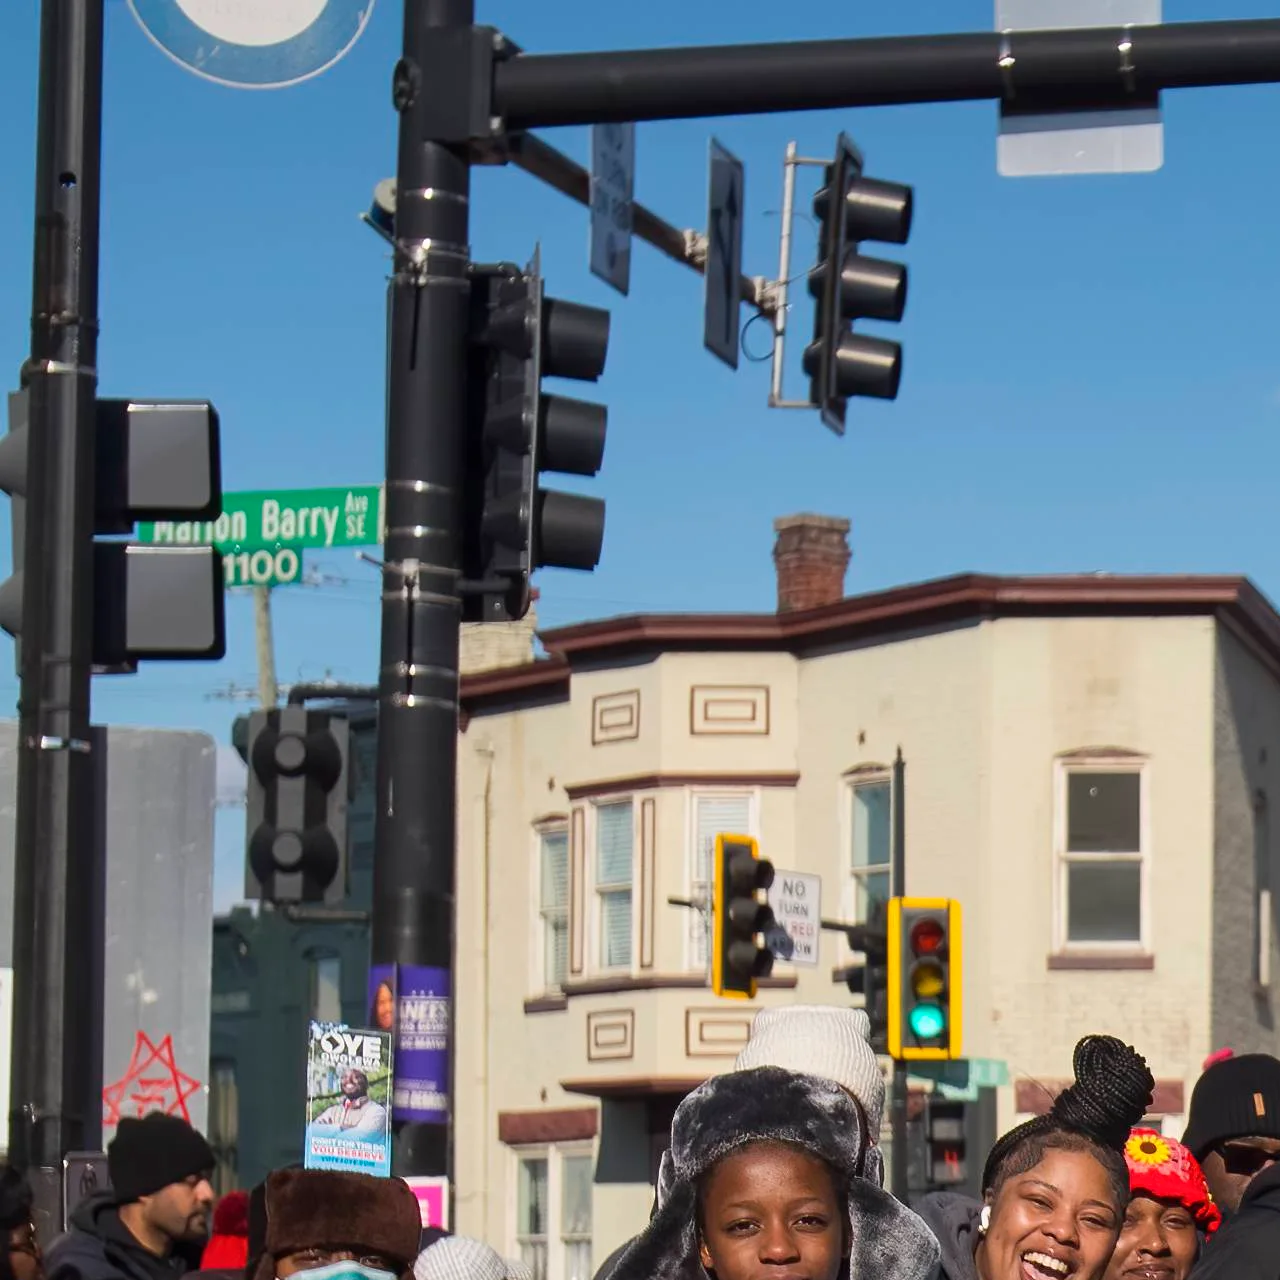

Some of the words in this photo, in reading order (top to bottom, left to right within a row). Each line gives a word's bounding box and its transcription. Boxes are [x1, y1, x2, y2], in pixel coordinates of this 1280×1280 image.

[261, 499, 339, 547] Barry
[344, 491, 368, 514] Ave
[345, 514, 366, 539] SE
[222, 549, 298, 584] 1100
[783, 879, 806, 897] NO
[778, 899, 809, 917] TURN
[790, 921, 814, 937] RED
[320, 1031, 381, 1060] OYE
